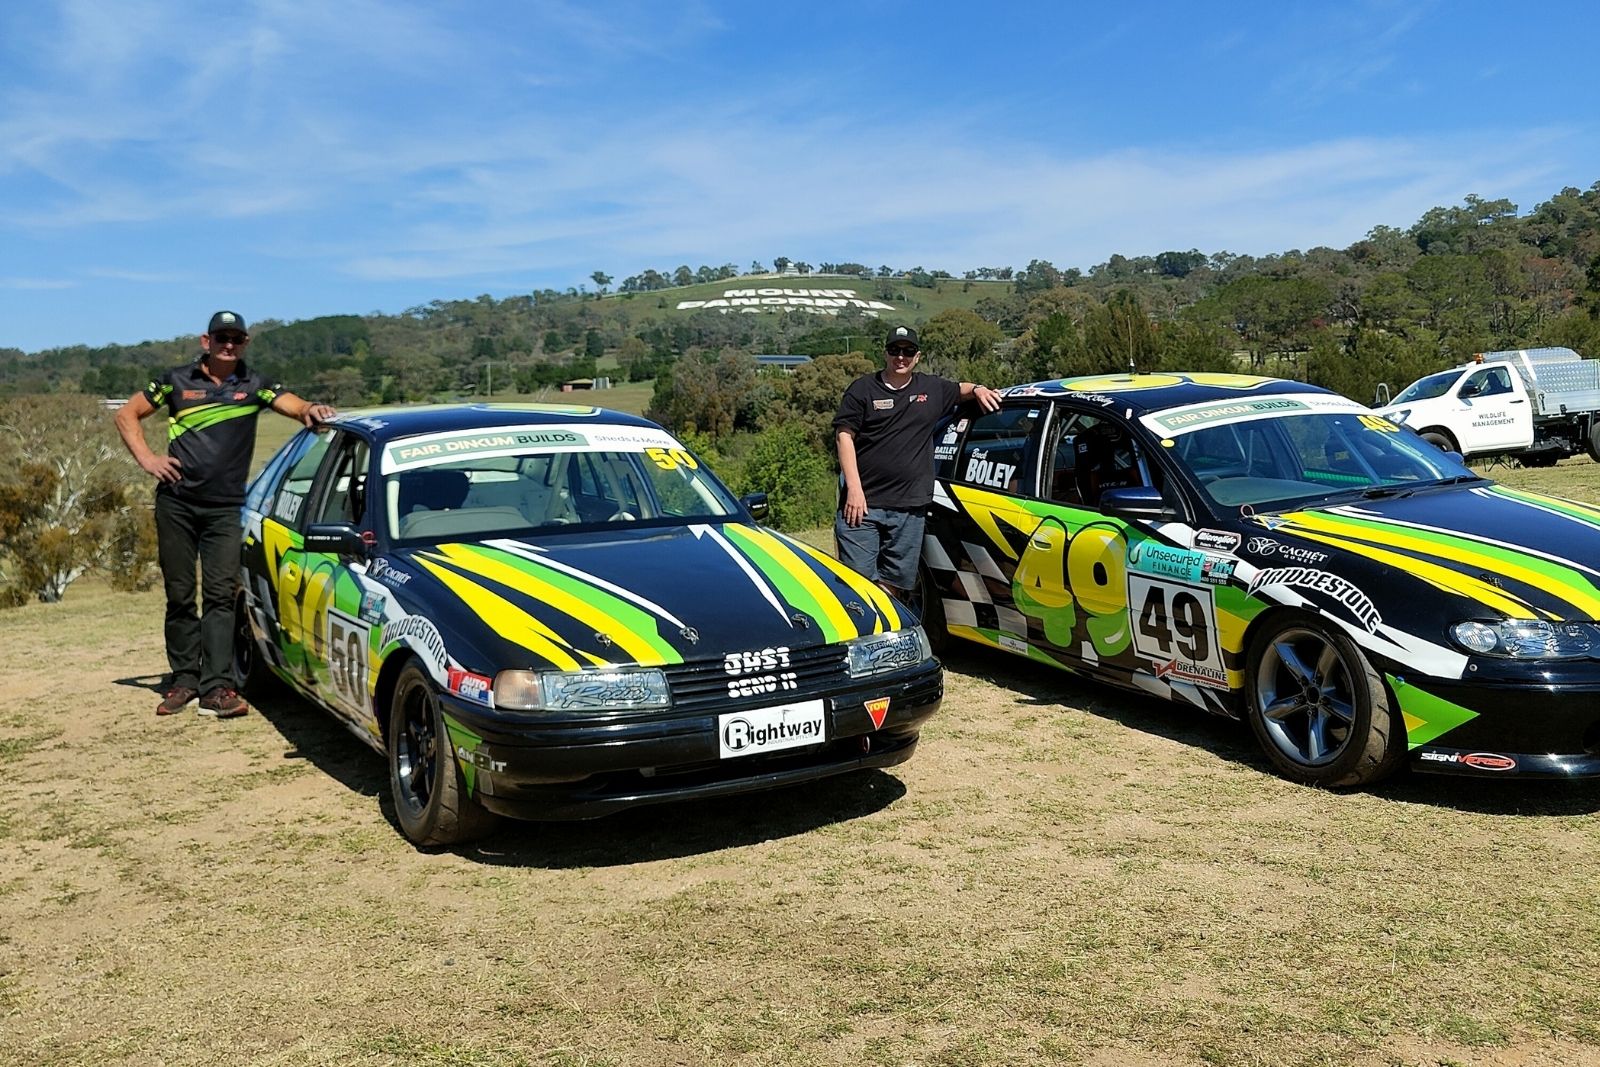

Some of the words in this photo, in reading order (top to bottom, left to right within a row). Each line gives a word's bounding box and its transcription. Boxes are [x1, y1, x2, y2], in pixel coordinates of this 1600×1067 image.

[723, 288, 856, 298] MOUNT
[676, 298, 896, 310] PANORAMA
[1165, 413, 1200, 427] FAIR
[1200, 404, 1252, 420] DINKUM
[1252, 400, 1299, 411] BUILDS
[1356, 415, 1400, 433] 49
[1472, 418, 1514, 427] MANAGEMENT
[1478, 412, 1506, 420] WILDLIFE
[400, 443, 442, 460] FAIR
[448, 435, 515, 452] DINKUM
[517, 432, 576, 445] BUILDS
[934, 446, 958, 455] BAILEY
[643, 447, 698, 471] 50
[964, 458, 1017, 490] BOLEY
[1146, 546, 1203, 567] Unsecured
[1284, 554, 1314, 564] HOMES
[1152, 562, 1192, 576] FINANCE
[1012, 514, 1129, 657] 49
[1245, 566, 1382, 635] BRIDGESTONE
[1138, 586, 1209, 663] 49
[380, 616, 448, 672] BRIDGESTONE
[332, 622, 365, 707] 50
[724, 646, 790, 676] JUST
[460, 684, 480, 699] ONE
[462, 676, 488, 690] AUTO
[868, 702, 888, 712] TOW
[723, 718, 822, 752] Rightway
